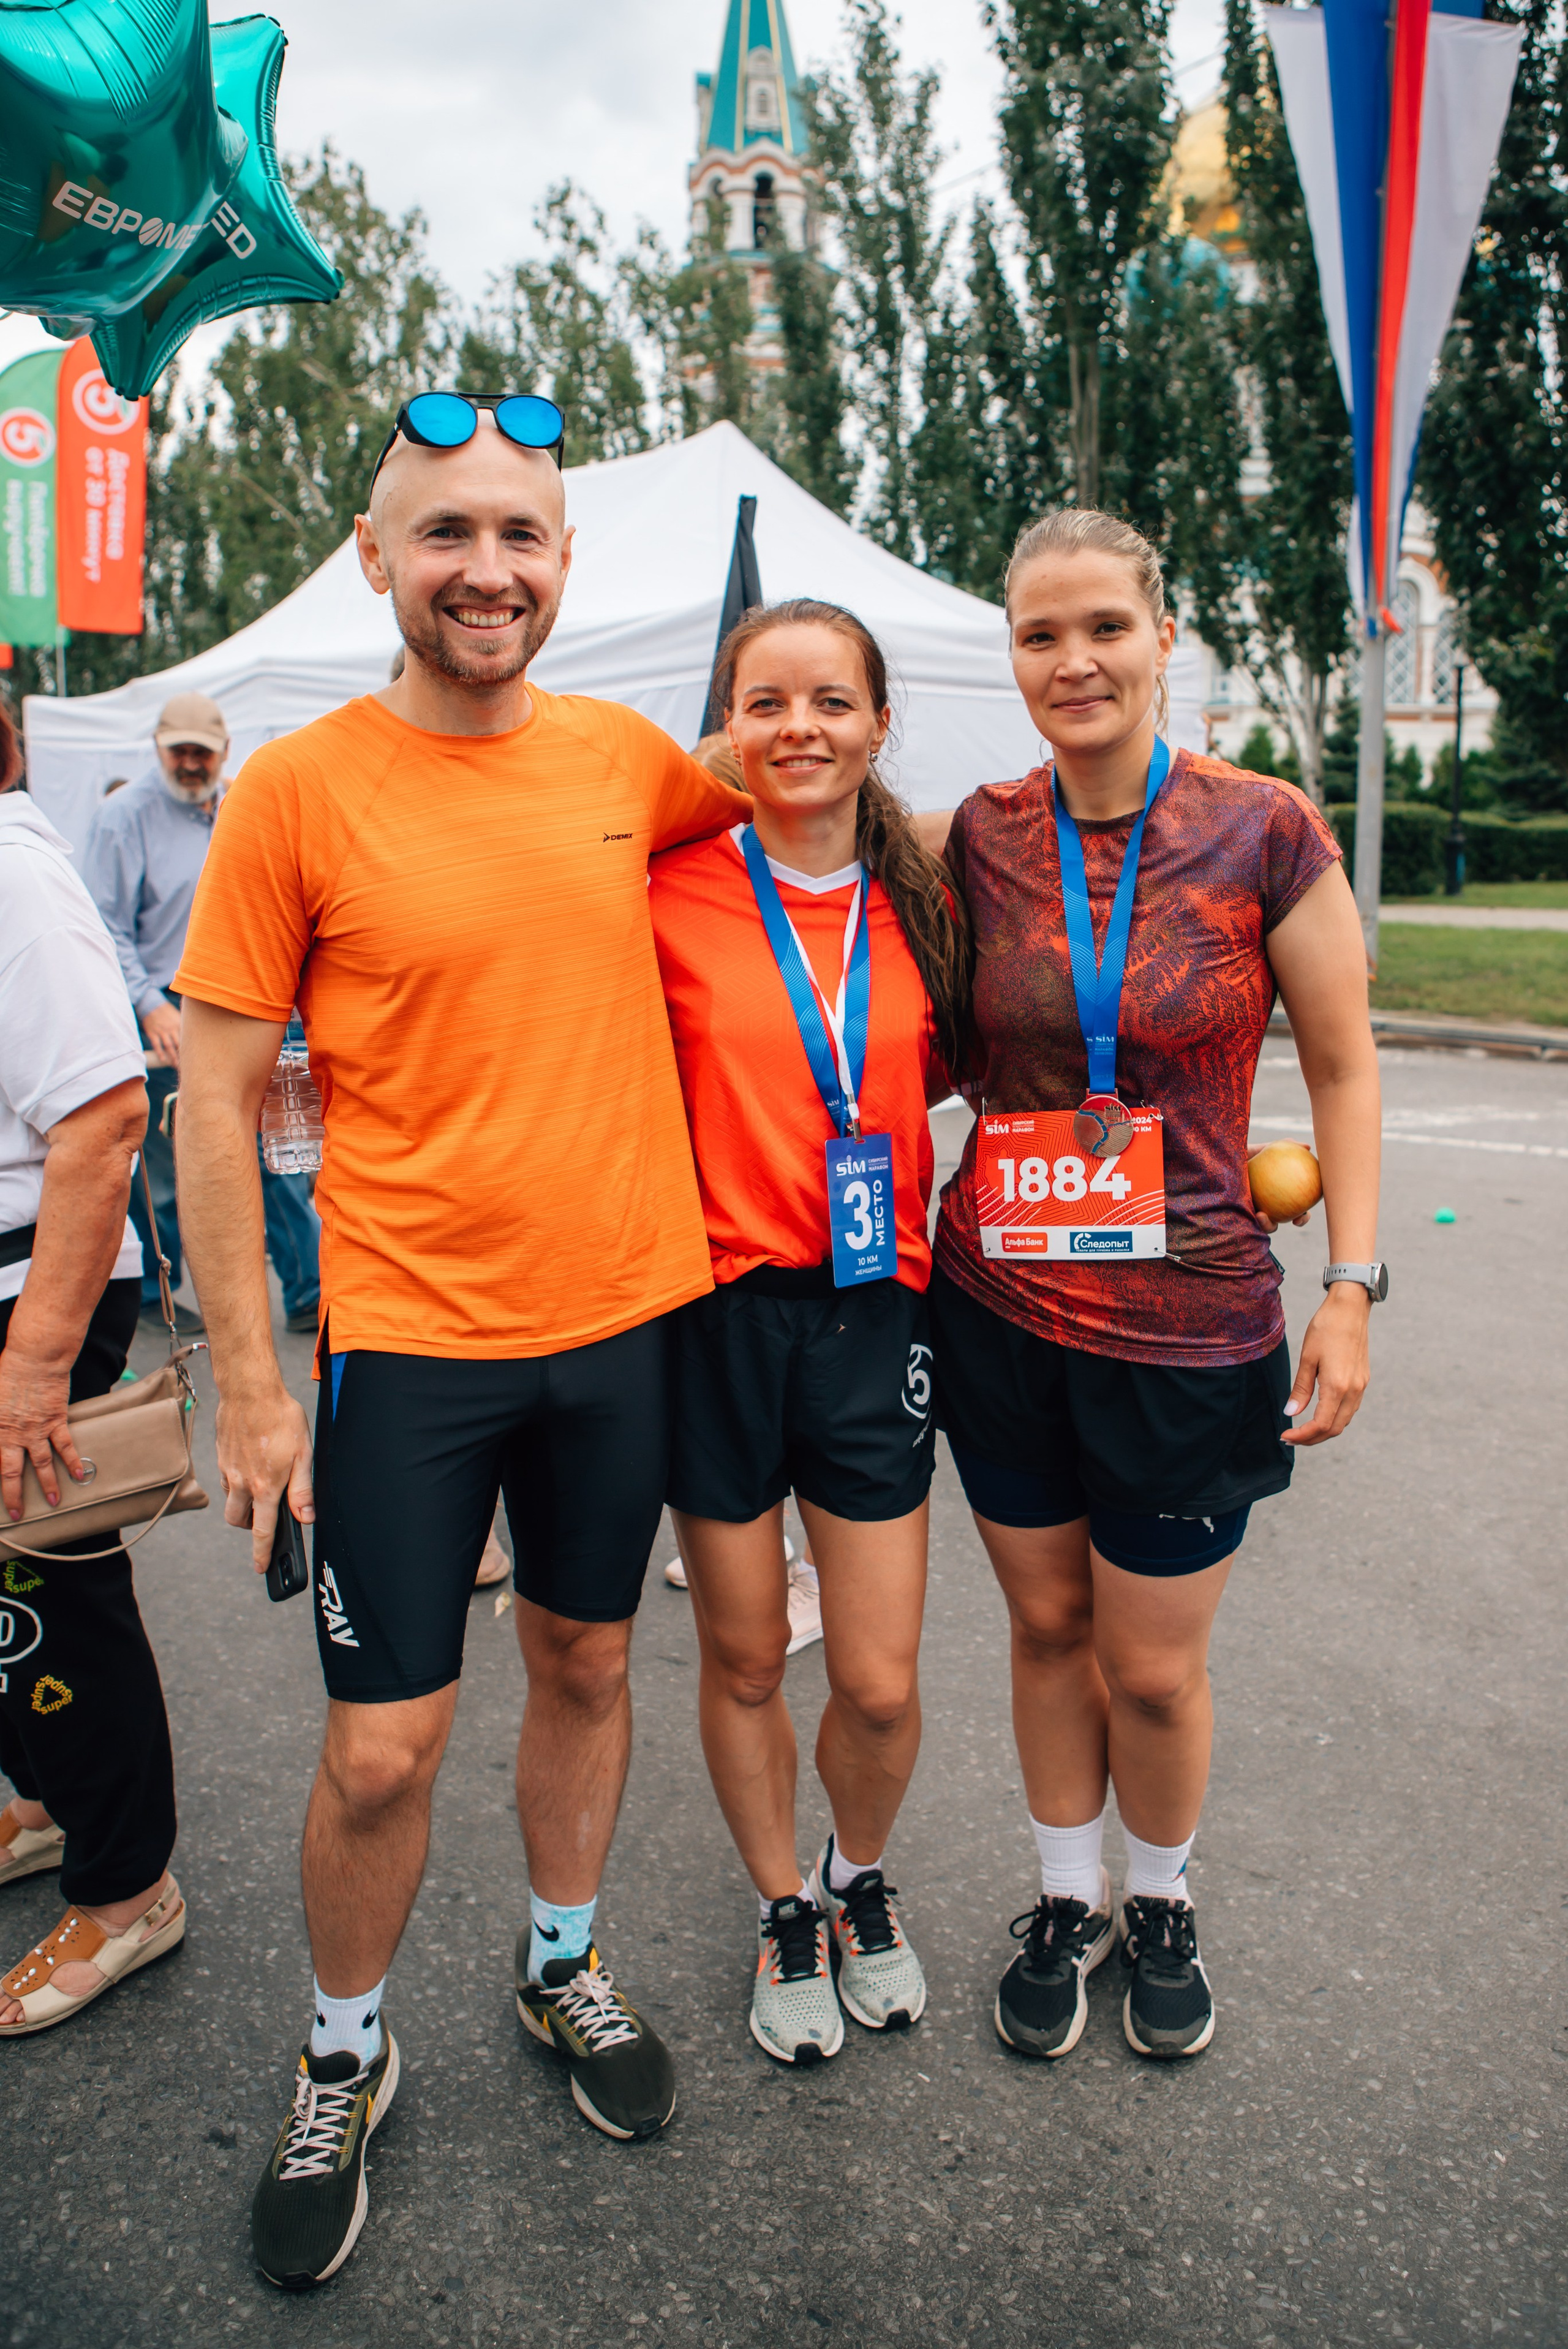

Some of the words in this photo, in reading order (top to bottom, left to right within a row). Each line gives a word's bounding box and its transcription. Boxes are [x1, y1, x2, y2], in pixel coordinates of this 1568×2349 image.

[998, 1155, 1132, 1202] 1884
[843, 1180, 873, 1250] 3
[873, 1179, 886, 1246] МЕСТО
[1005, 1237, 1025, 1248] Альфа
[1026, 1237, 1044, 1246] Банк
[1080, 1239, 1129, 1248] Следопыт
[855, 1265, 883, 1276] ЖЕНЩИНЫ
[858, 1257, 866, 1266] 10
[867, 1254, 878, 1264] КМ
[31, 1681, 46, 1712] super
[39, 1674, 74, 1697] super
[40, 1693, 73, 1715] super
